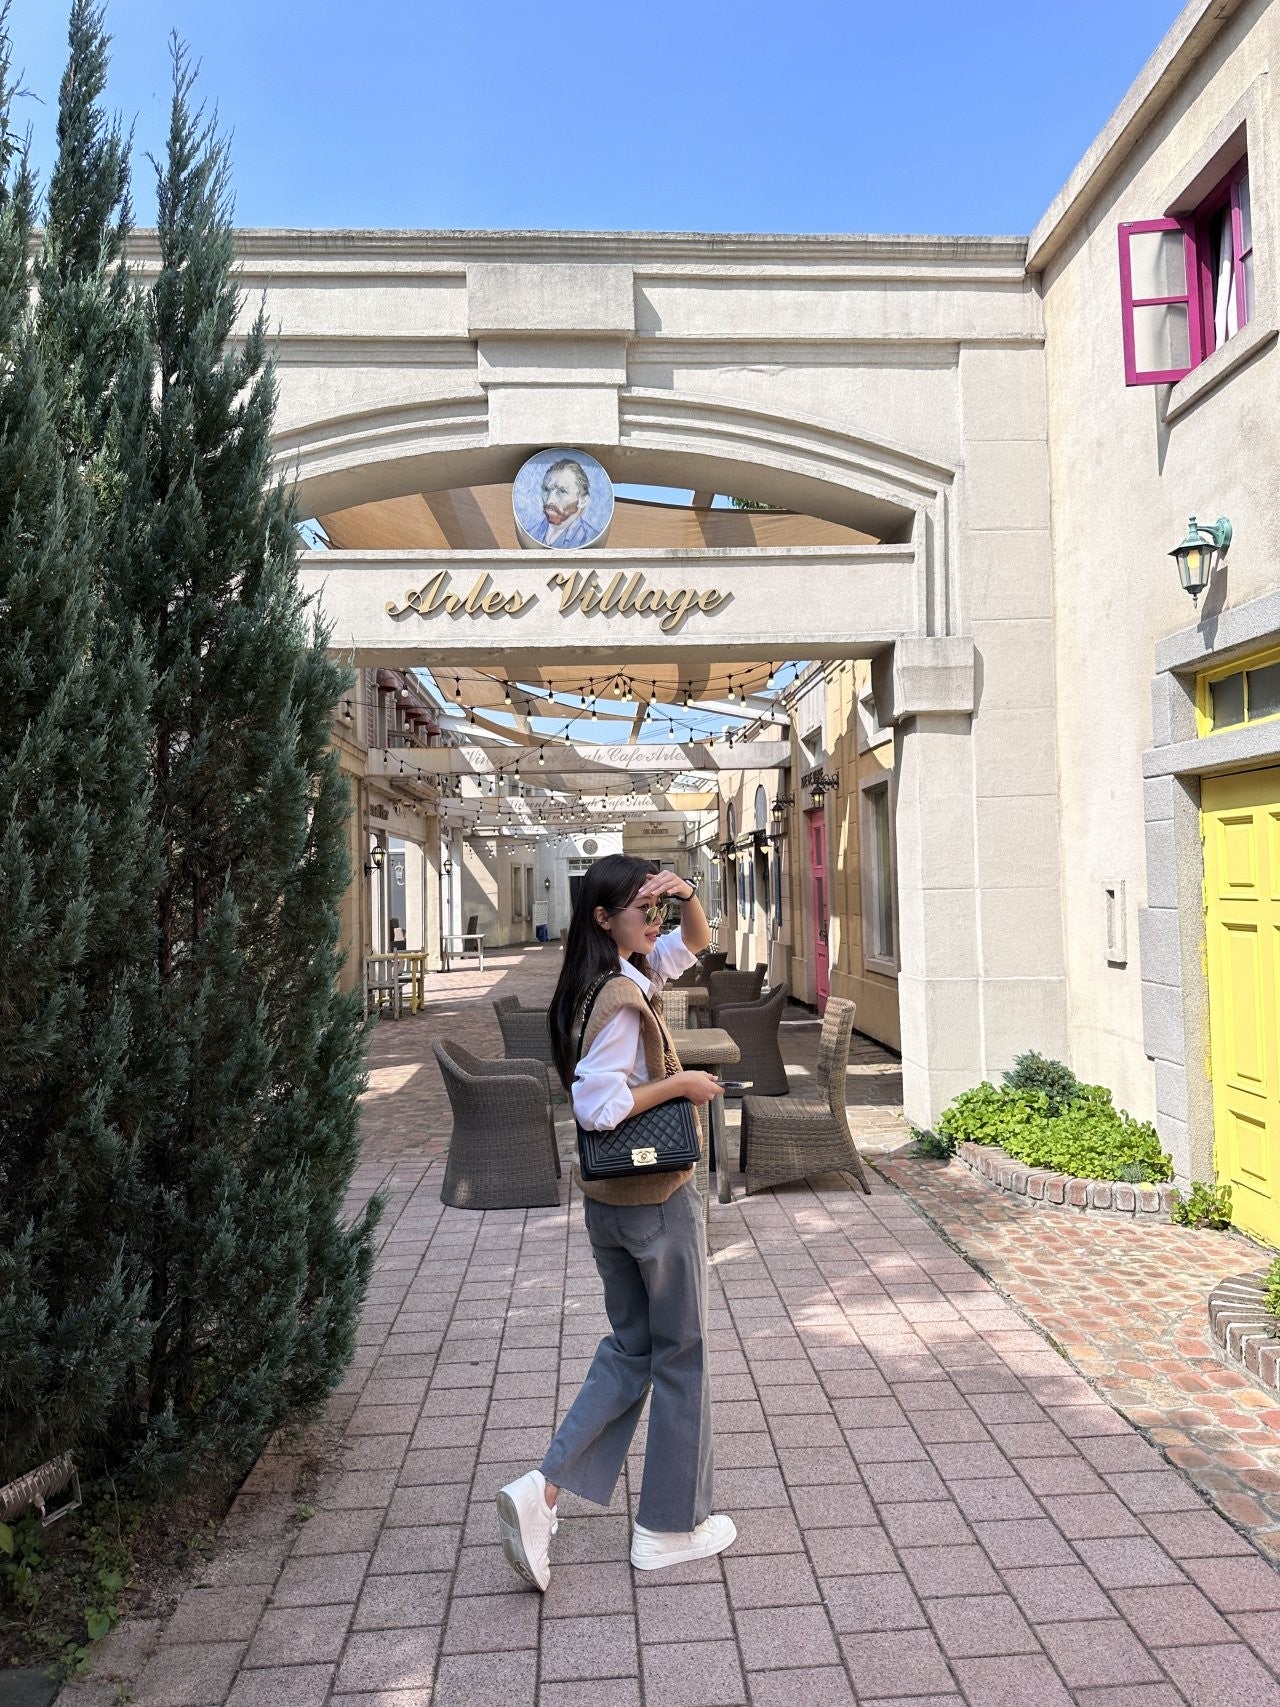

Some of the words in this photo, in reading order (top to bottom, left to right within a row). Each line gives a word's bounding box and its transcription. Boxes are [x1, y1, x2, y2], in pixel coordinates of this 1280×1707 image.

[384, 569, 537, 615] Arles
[546, 569, 734, 632] Village
[607, 745, 646, 768] Cafe
[646, 745, 689, 762] Arles
